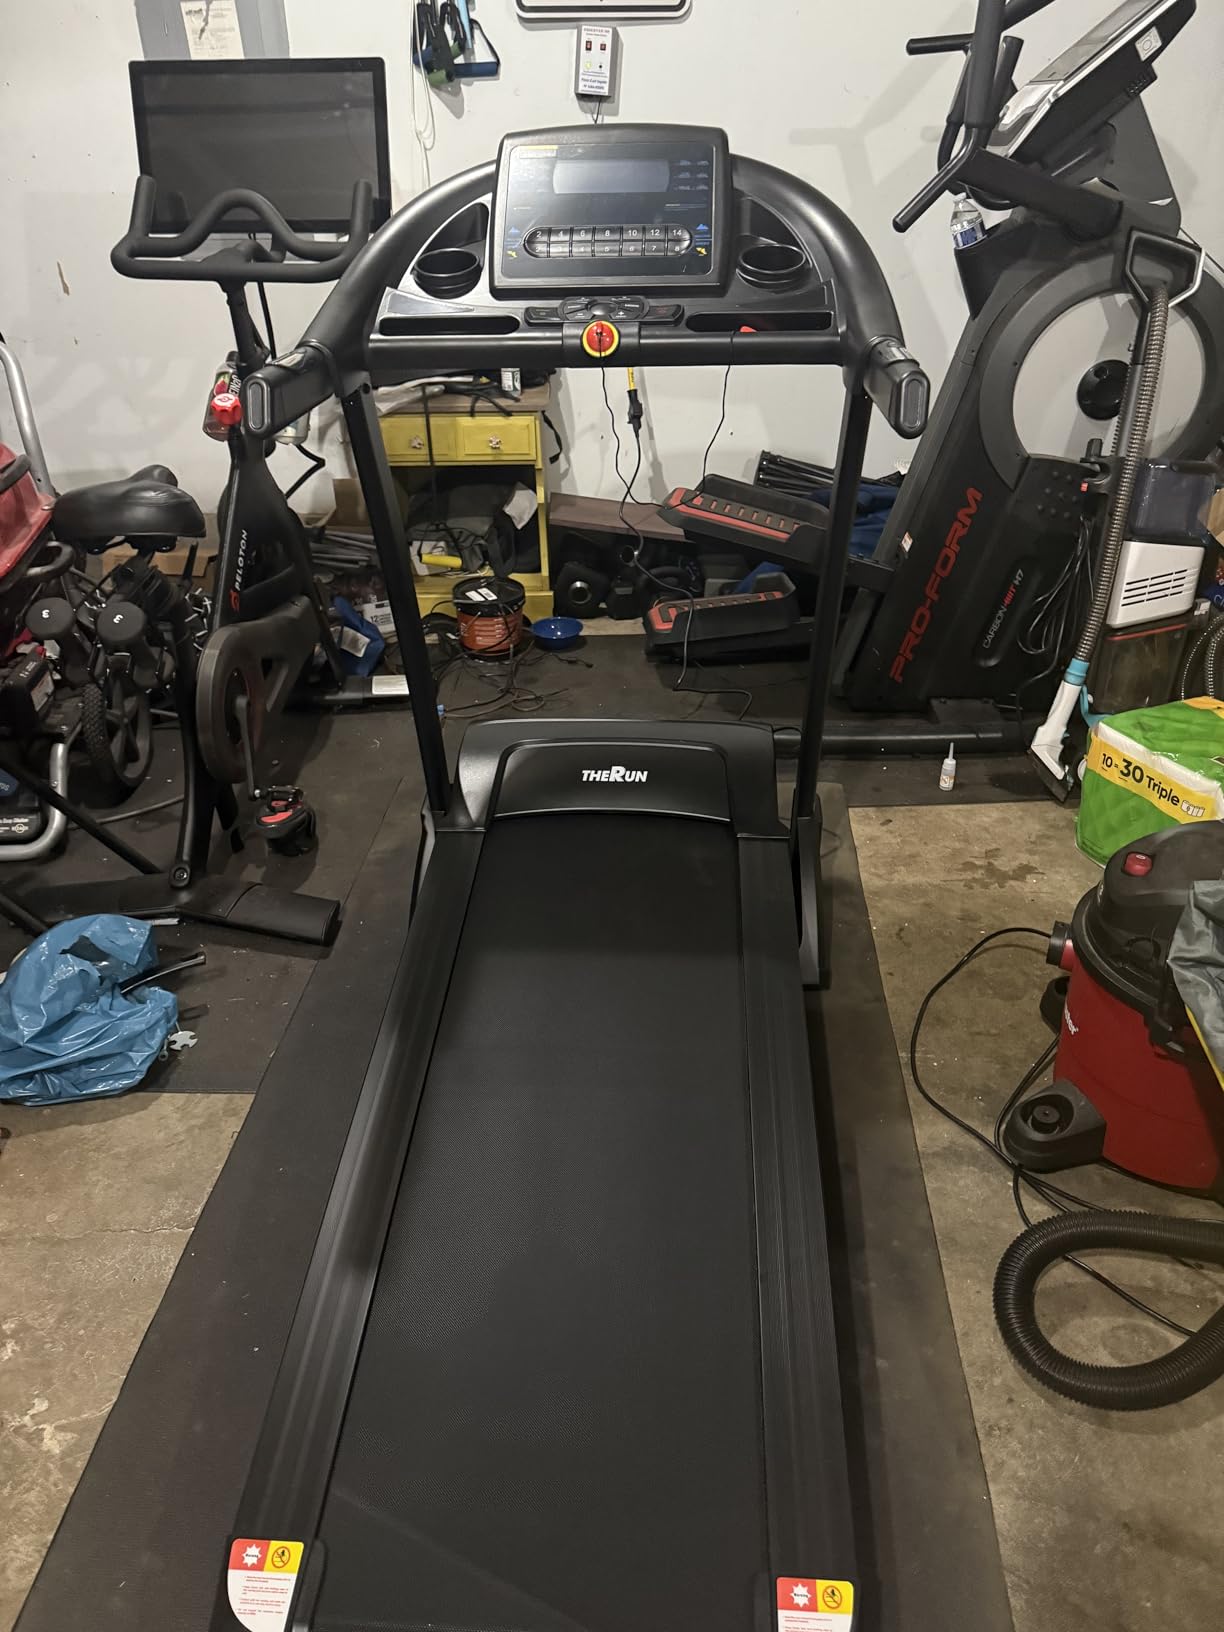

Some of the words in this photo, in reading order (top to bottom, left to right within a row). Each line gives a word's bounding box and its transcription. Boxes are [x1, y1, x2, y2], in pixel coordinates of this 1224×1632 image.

[604, 229, 610, 237] 8
[628, 229, 638, 237] 10
[234, 529, 248, 591] PELOTON
[889, 487, 984, 684] PRO-FORM
[41, 609, 50, 619] 3
[113, 614, 124, 624] 3
[983, 605, 1007, 649] CARBON
[1013, 568, 1024, 586] H7
[1102, 753, 1113, 768] 10
[1120, 758, 1144, 784] 30
[1146, 775, 1180, 807] Triple
